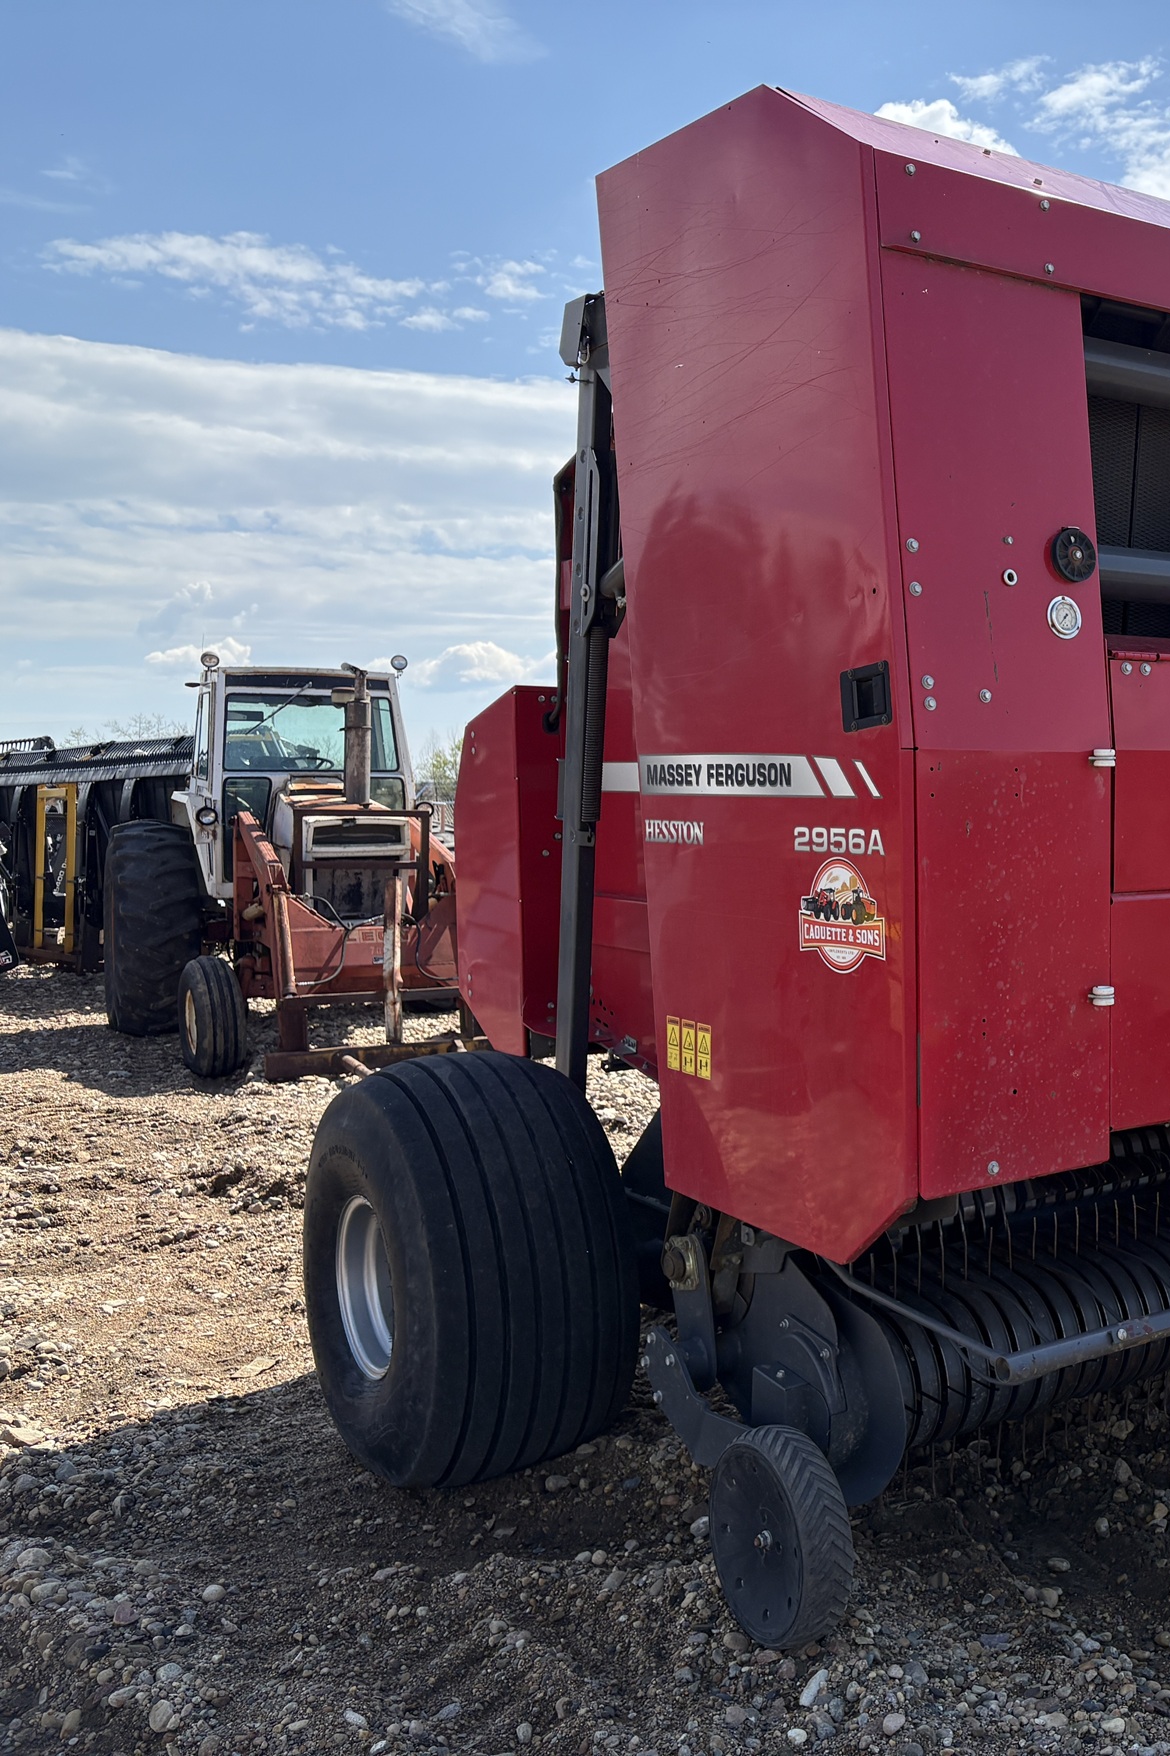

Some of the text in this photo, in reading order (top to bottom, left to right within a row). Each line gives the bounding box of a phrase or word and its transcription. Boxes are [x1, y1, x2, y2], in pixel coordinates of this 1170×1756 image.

[646, 762, 792, 788] MASSEY FERGUSON
[644, 819, 704, 845] HESSTON
[793, 826, 886, 856] 2956A
[848, 928, 855, 943] &
[855, 928, 880, 947] SONS
